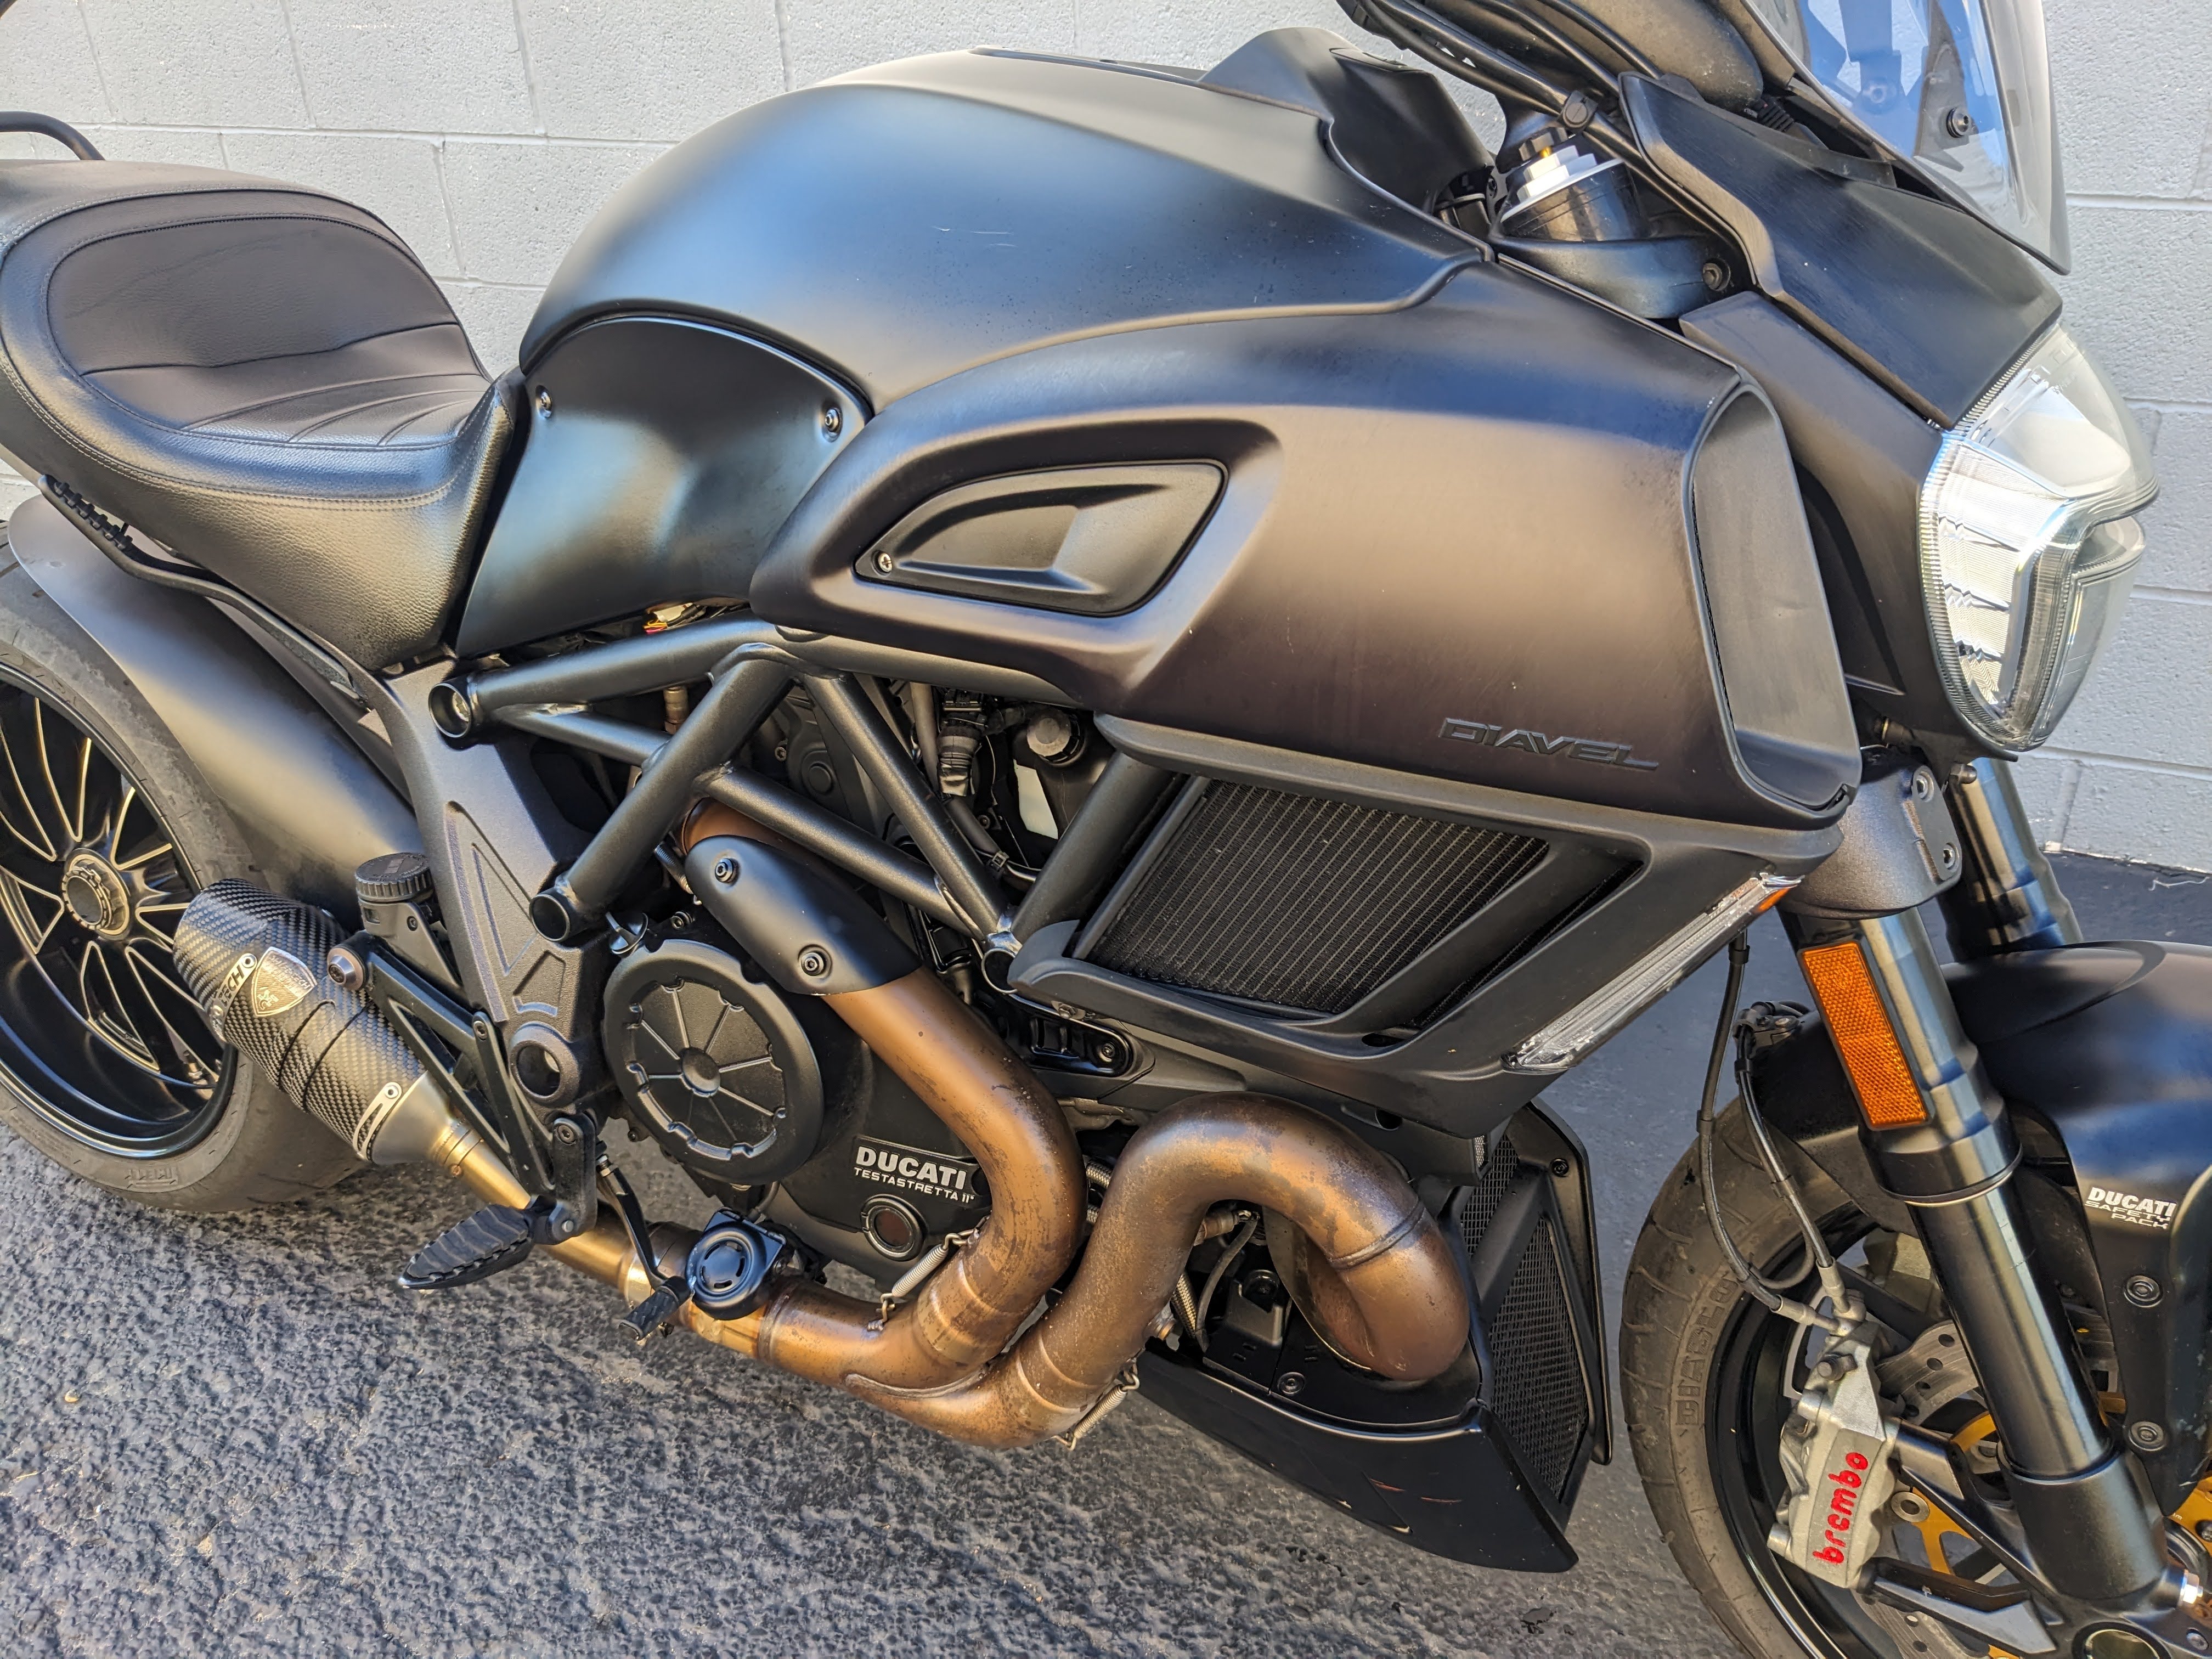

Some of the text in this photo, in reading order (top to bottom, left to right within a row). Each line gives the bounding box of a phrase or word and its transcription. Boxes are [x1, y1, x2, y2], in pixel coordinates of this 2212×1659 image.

[1438, 718, 1659, 771] DIAVEL
[856, 1146, 967, 1189] DUCATI
[854, 1167, 959, 1201] TESTASTRETTA
[2085, 1200, 2171, 1222] SAFETY
[2087, 1187, 2177, 1217] DUCATI
[2111, 1212, 2169, 1230] PACK
